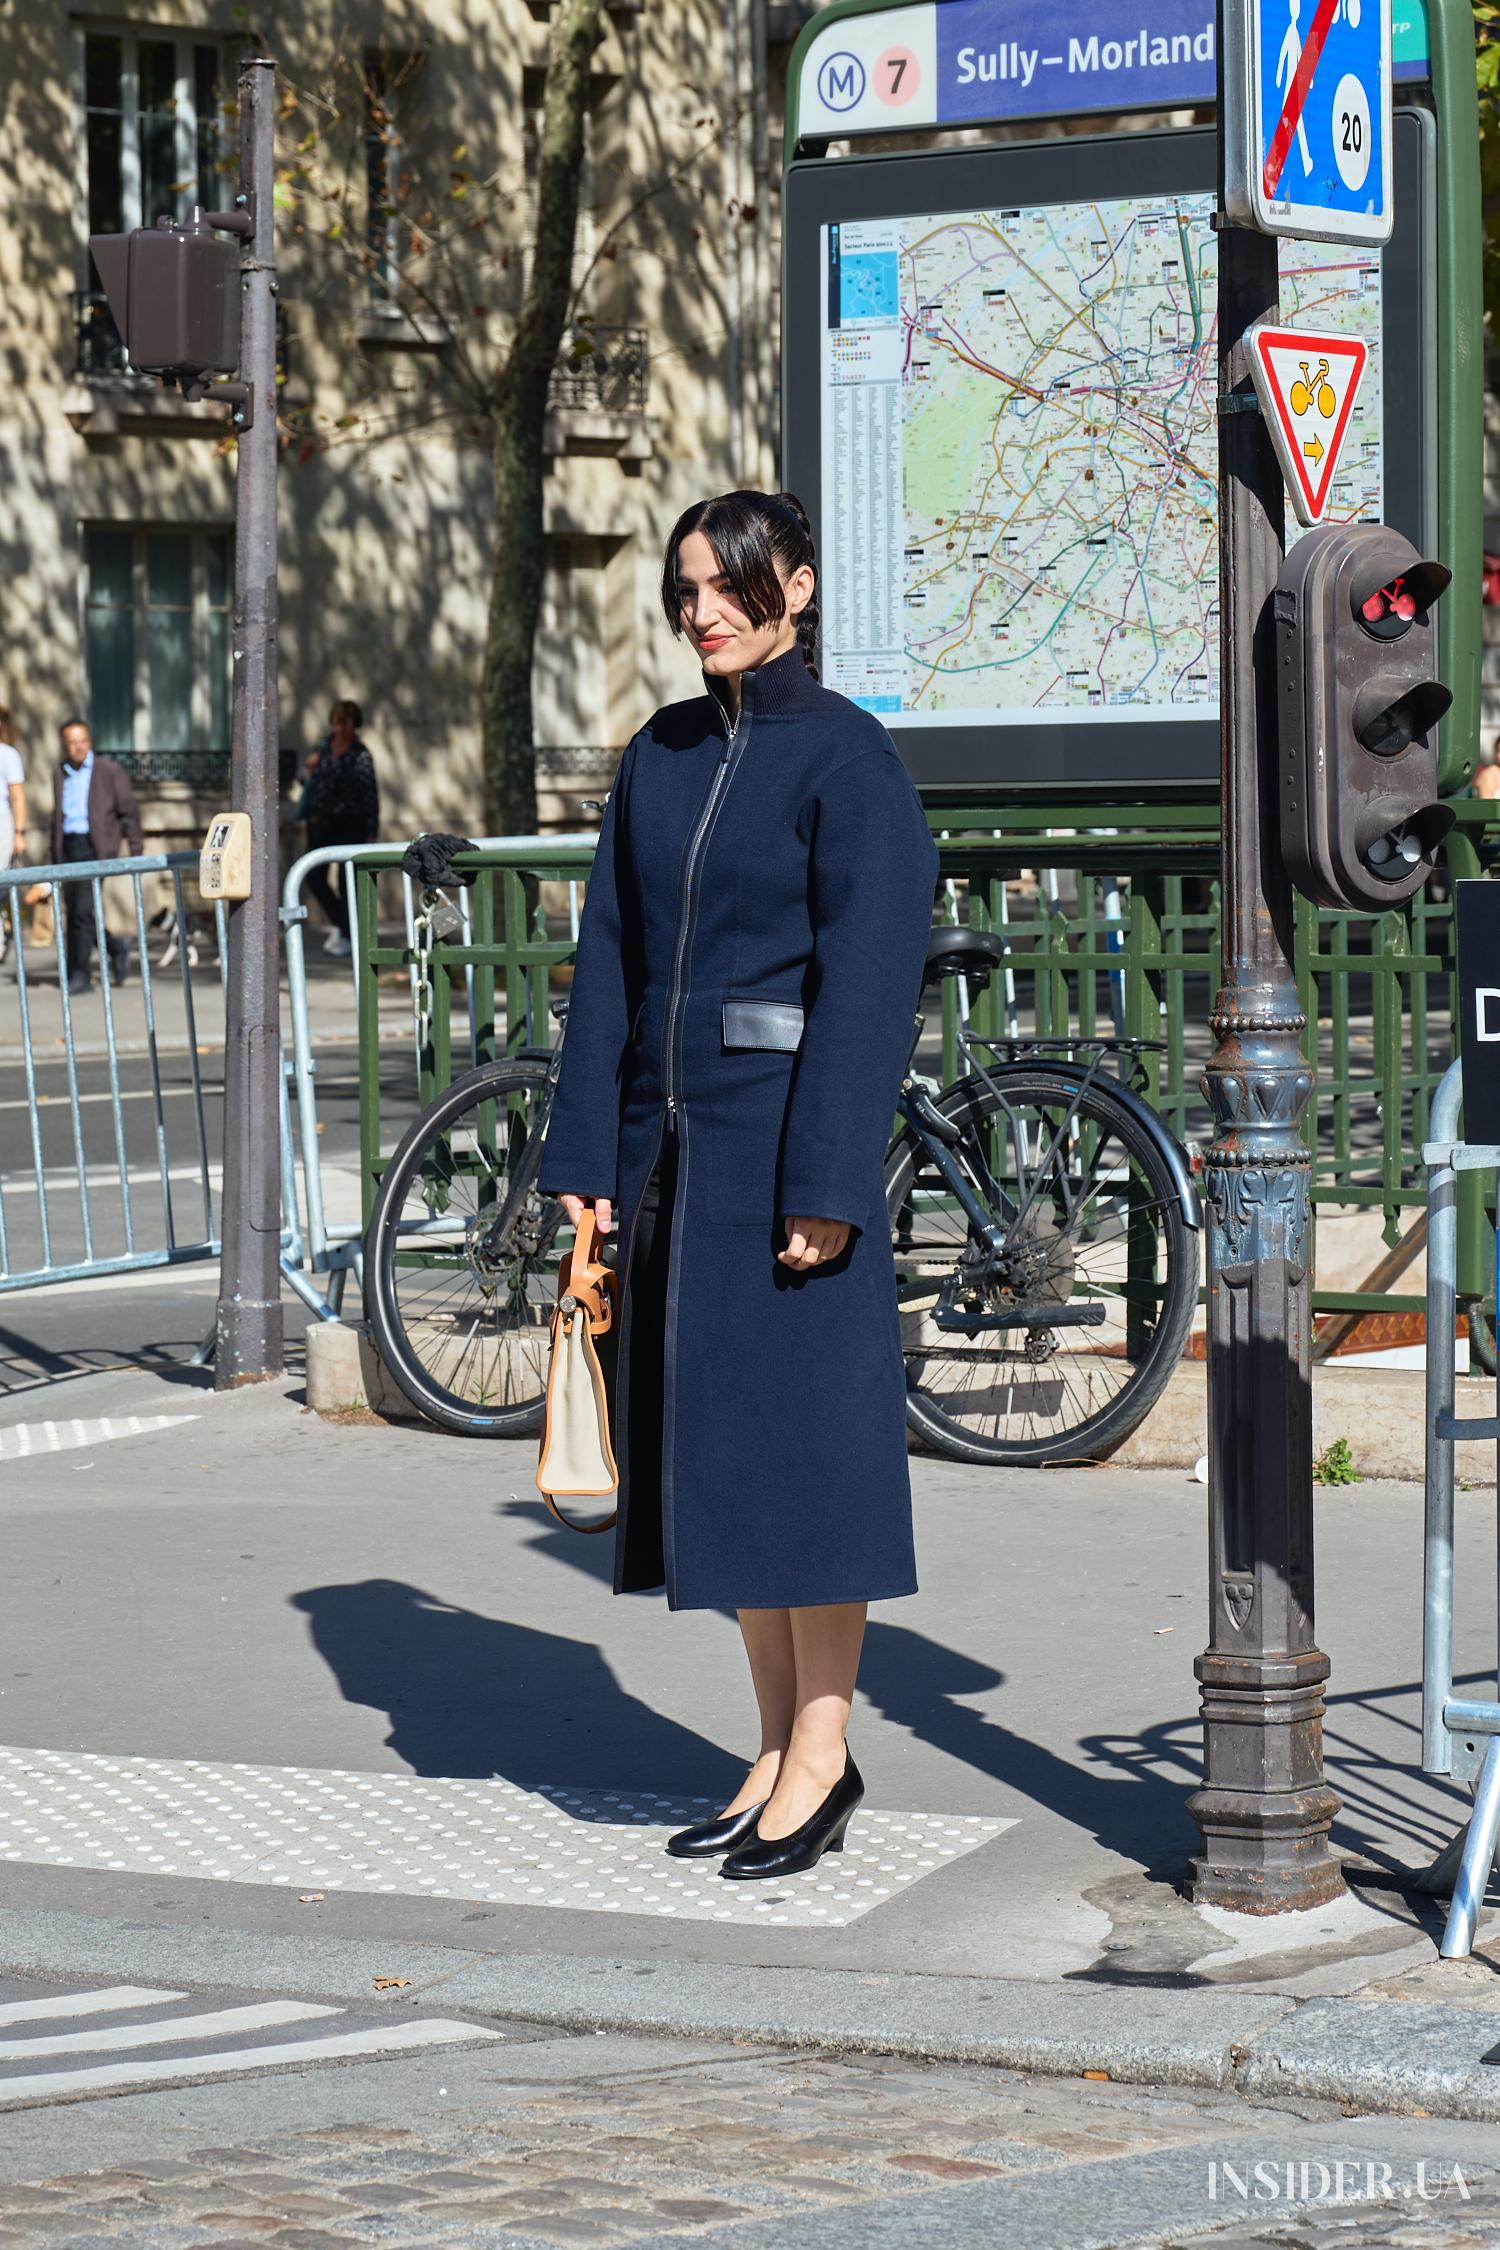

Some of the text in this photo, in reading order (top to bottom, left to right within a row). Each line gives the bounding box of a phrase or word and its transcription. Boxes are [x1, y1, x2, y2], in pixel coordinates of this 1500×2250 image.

[1391, 21, 1411, 34] TP
[829, 65, 853, 99] M
[887, 59, 907, 94] 7
[1342, 112, 1362, 152] 20
